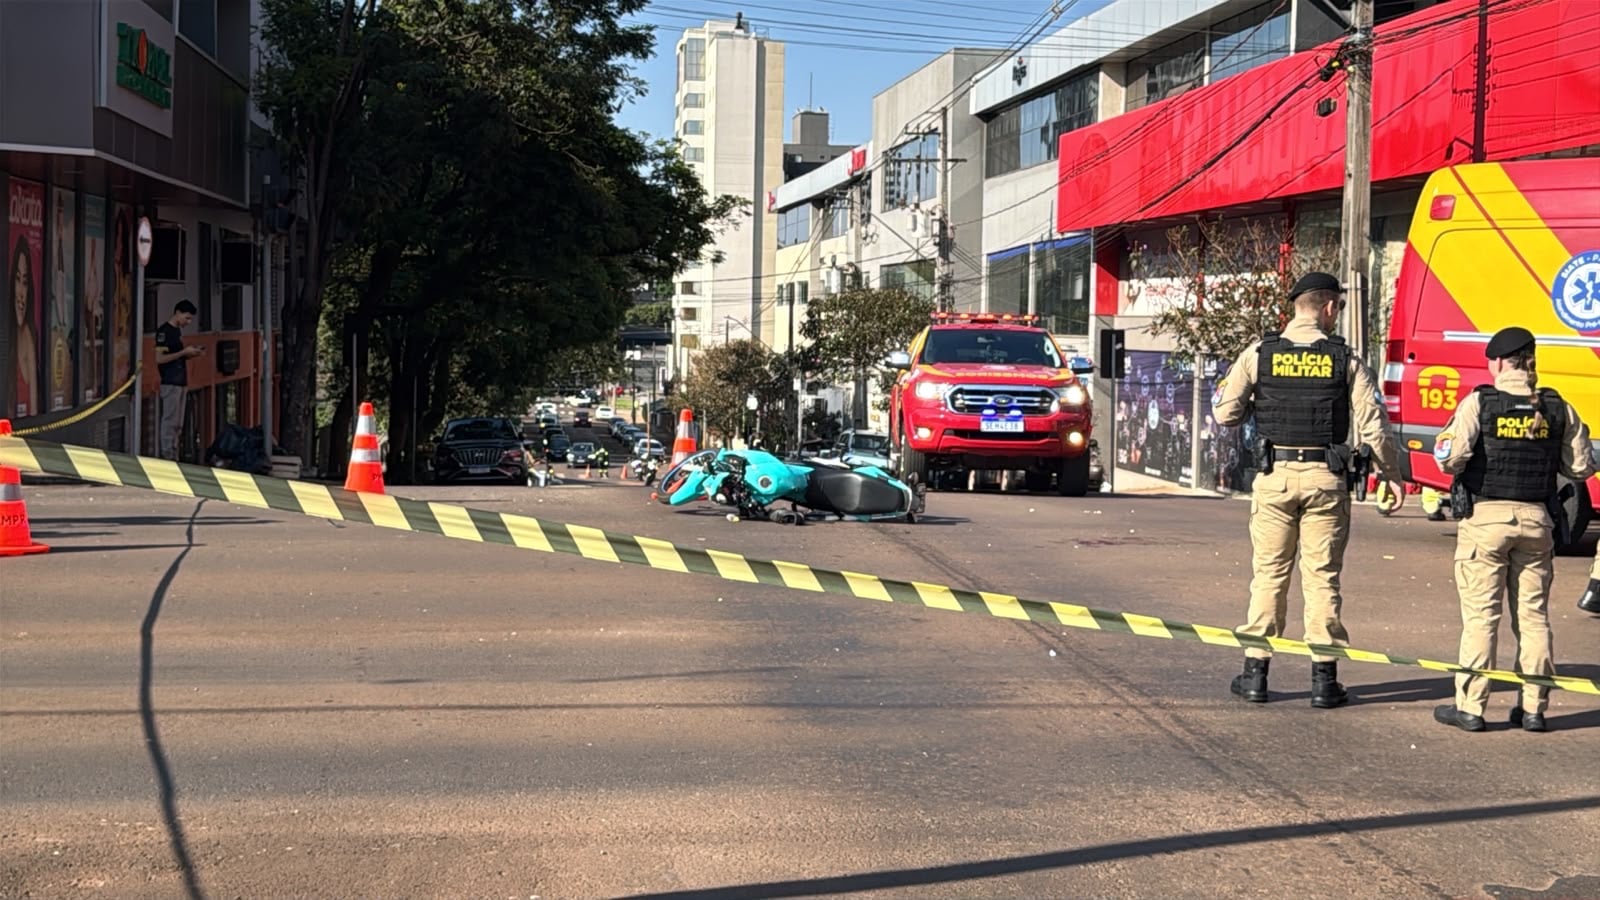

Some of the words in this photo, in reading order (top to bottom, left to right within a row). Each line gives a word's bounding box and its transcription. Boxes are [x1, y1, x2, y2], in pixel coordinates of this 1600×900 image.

[1272, 351, 1333, 366] POLÍCIA
[1272, 365, 1333, 377] MILITAR
[1419, 388, 1457, 410] 193
[1497, 416, 1549, 428] POLÍCA
